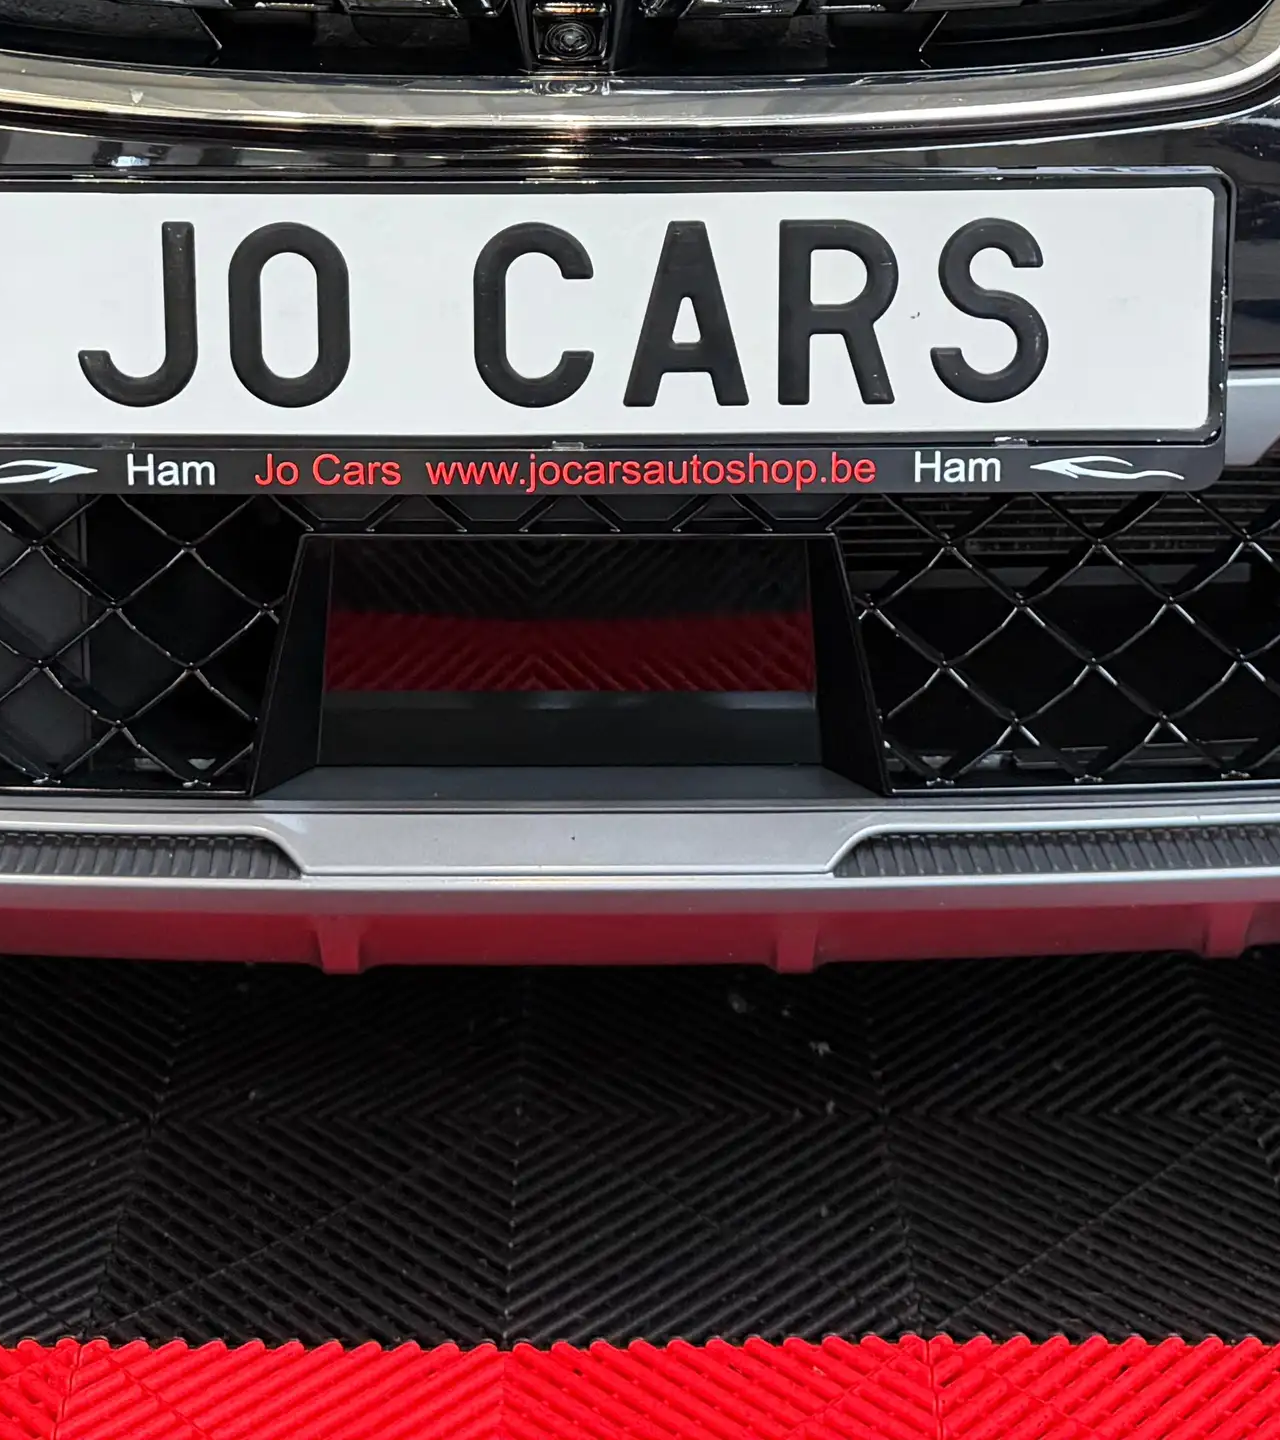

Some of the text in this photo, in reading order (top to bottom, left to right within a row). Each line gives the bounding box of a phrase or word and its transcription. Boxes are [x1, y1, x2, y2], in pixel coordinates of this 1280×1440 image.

[77, 217, 1049, 408] JO CARS
[126, 449, 1002, 495] Ham Jo Cars www.jocarsautoshop.be Ham
